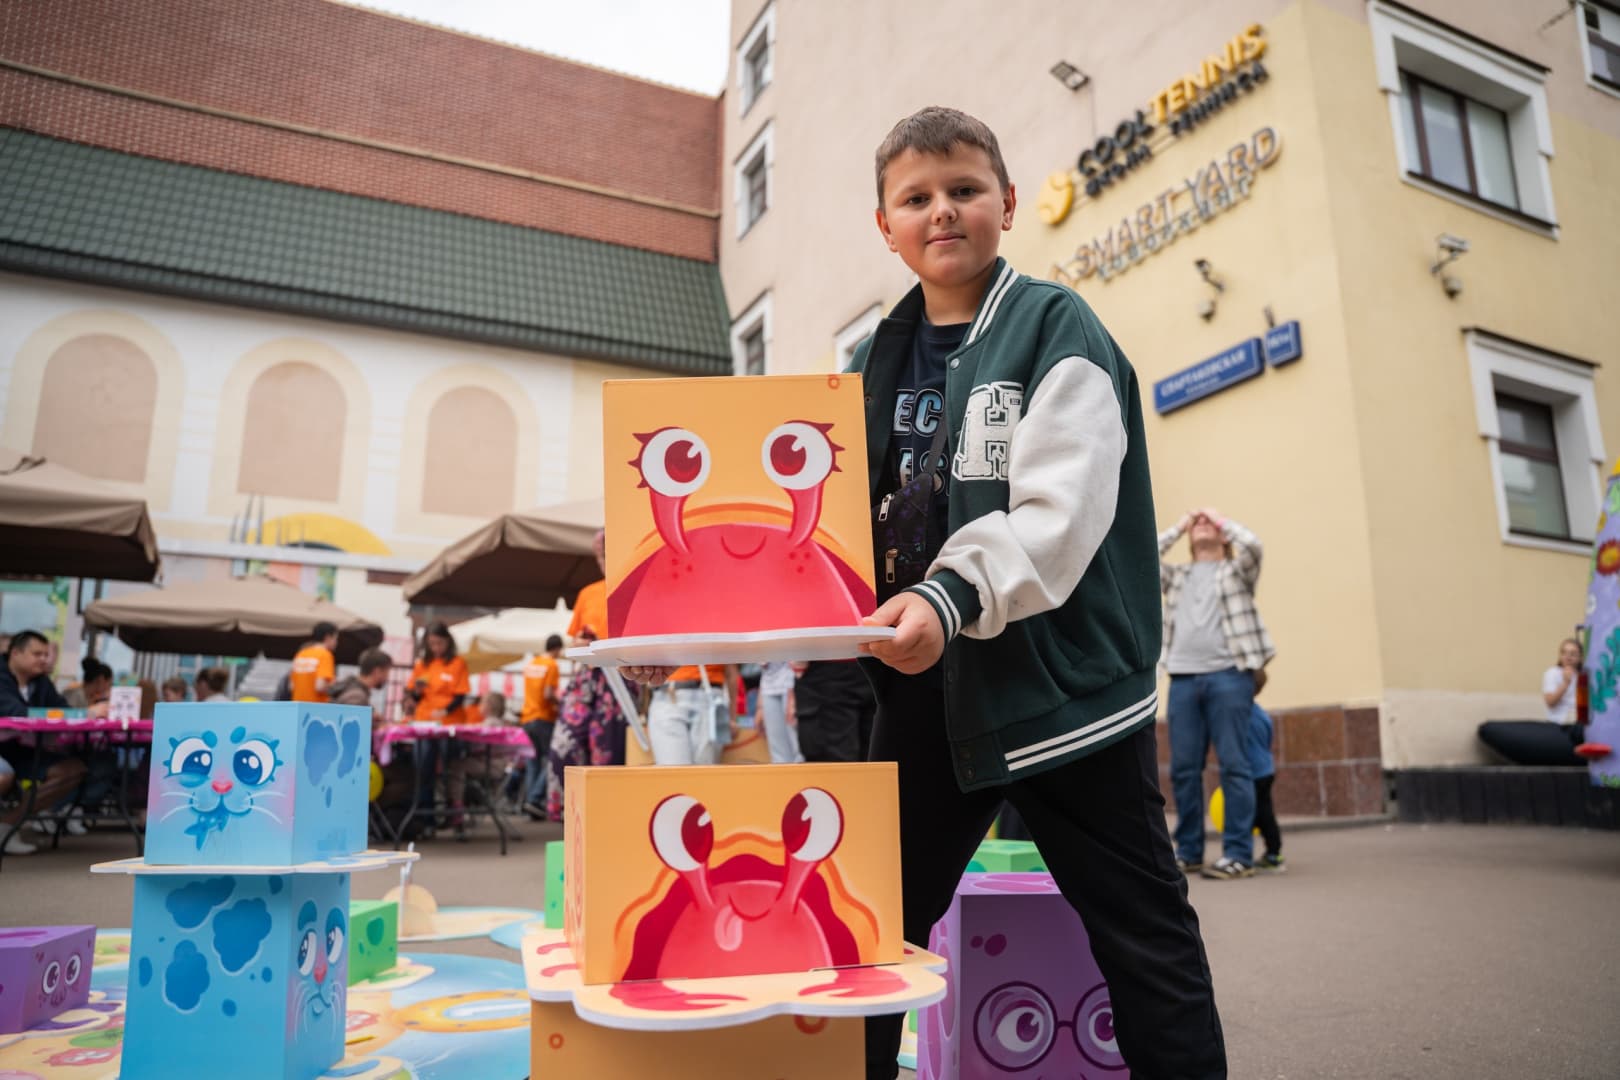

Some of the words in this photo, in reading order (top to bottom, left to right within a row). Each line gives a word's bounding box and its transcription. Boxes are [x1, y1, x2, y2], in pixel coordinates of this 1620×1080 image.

[1078, 109, 1154, 177] COOL
[1150, 23, 1269, 123] TENNIS
[1075, 188, 1177, 278] SMART
[1184, 127, 1281, 214] YARD
